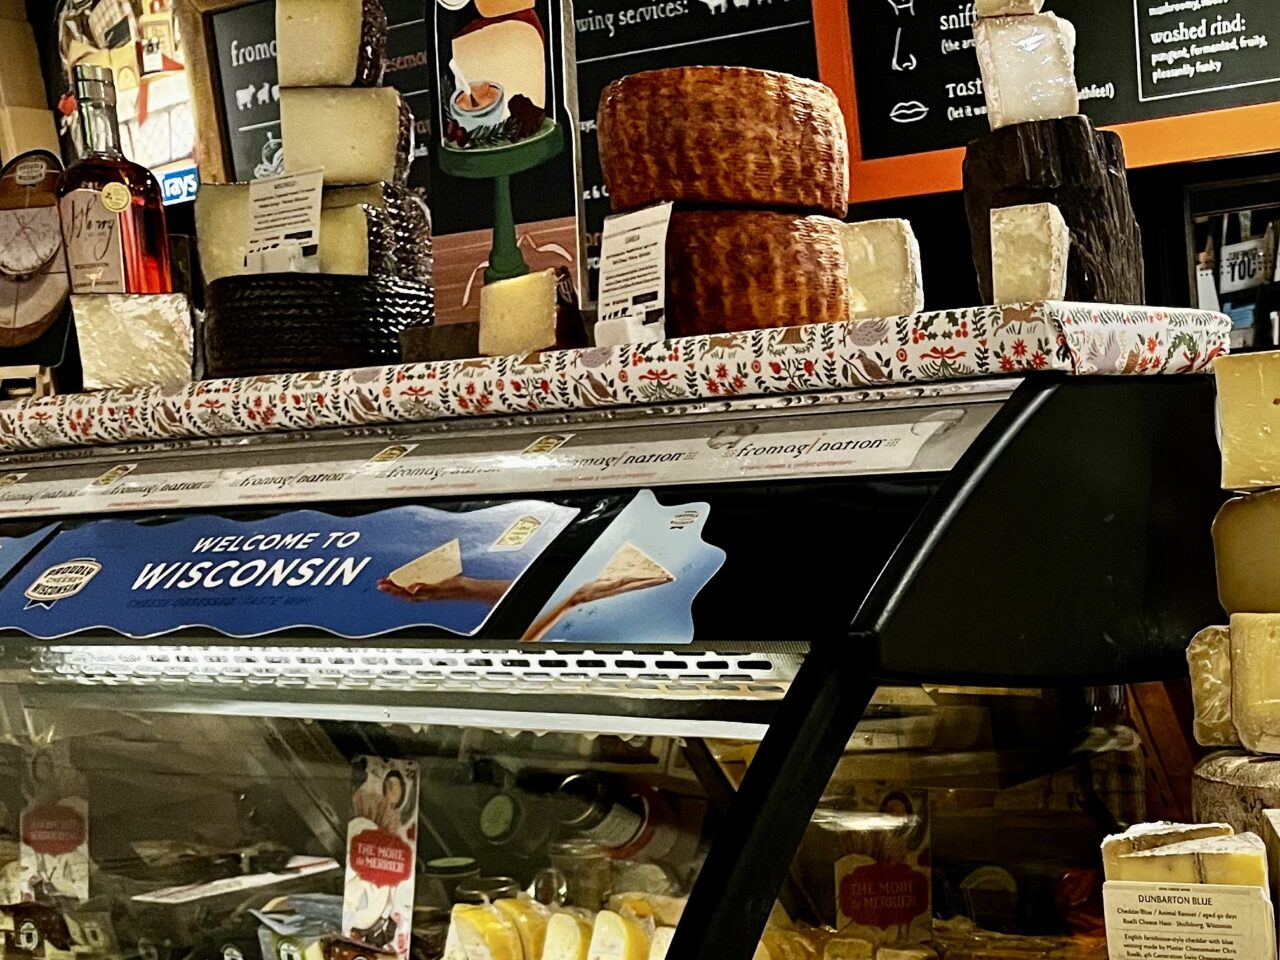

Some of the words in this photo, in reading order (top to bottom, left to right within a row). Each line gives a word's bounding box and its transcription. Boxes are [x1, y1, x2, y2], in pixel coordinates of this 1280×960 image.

[619, 0, 688, 25] services:
[1151, 18, 1206, 44] washed
[1210, 13, 1246, 36] rind:
[945, 78, 982, 98] Tast
[191, 532, 320, 553] WELCOME
[325, 532, 361, 548] TO
[44, 565, 95, 578] PROUDLY
[131, 557, 372, 590] WISCONSIN
[31, 582, 83, 595] WISCONSIN
[1138, 895, 1190, 905] DUNBARTON
[1192, 897, 1212, 906] BLUE
